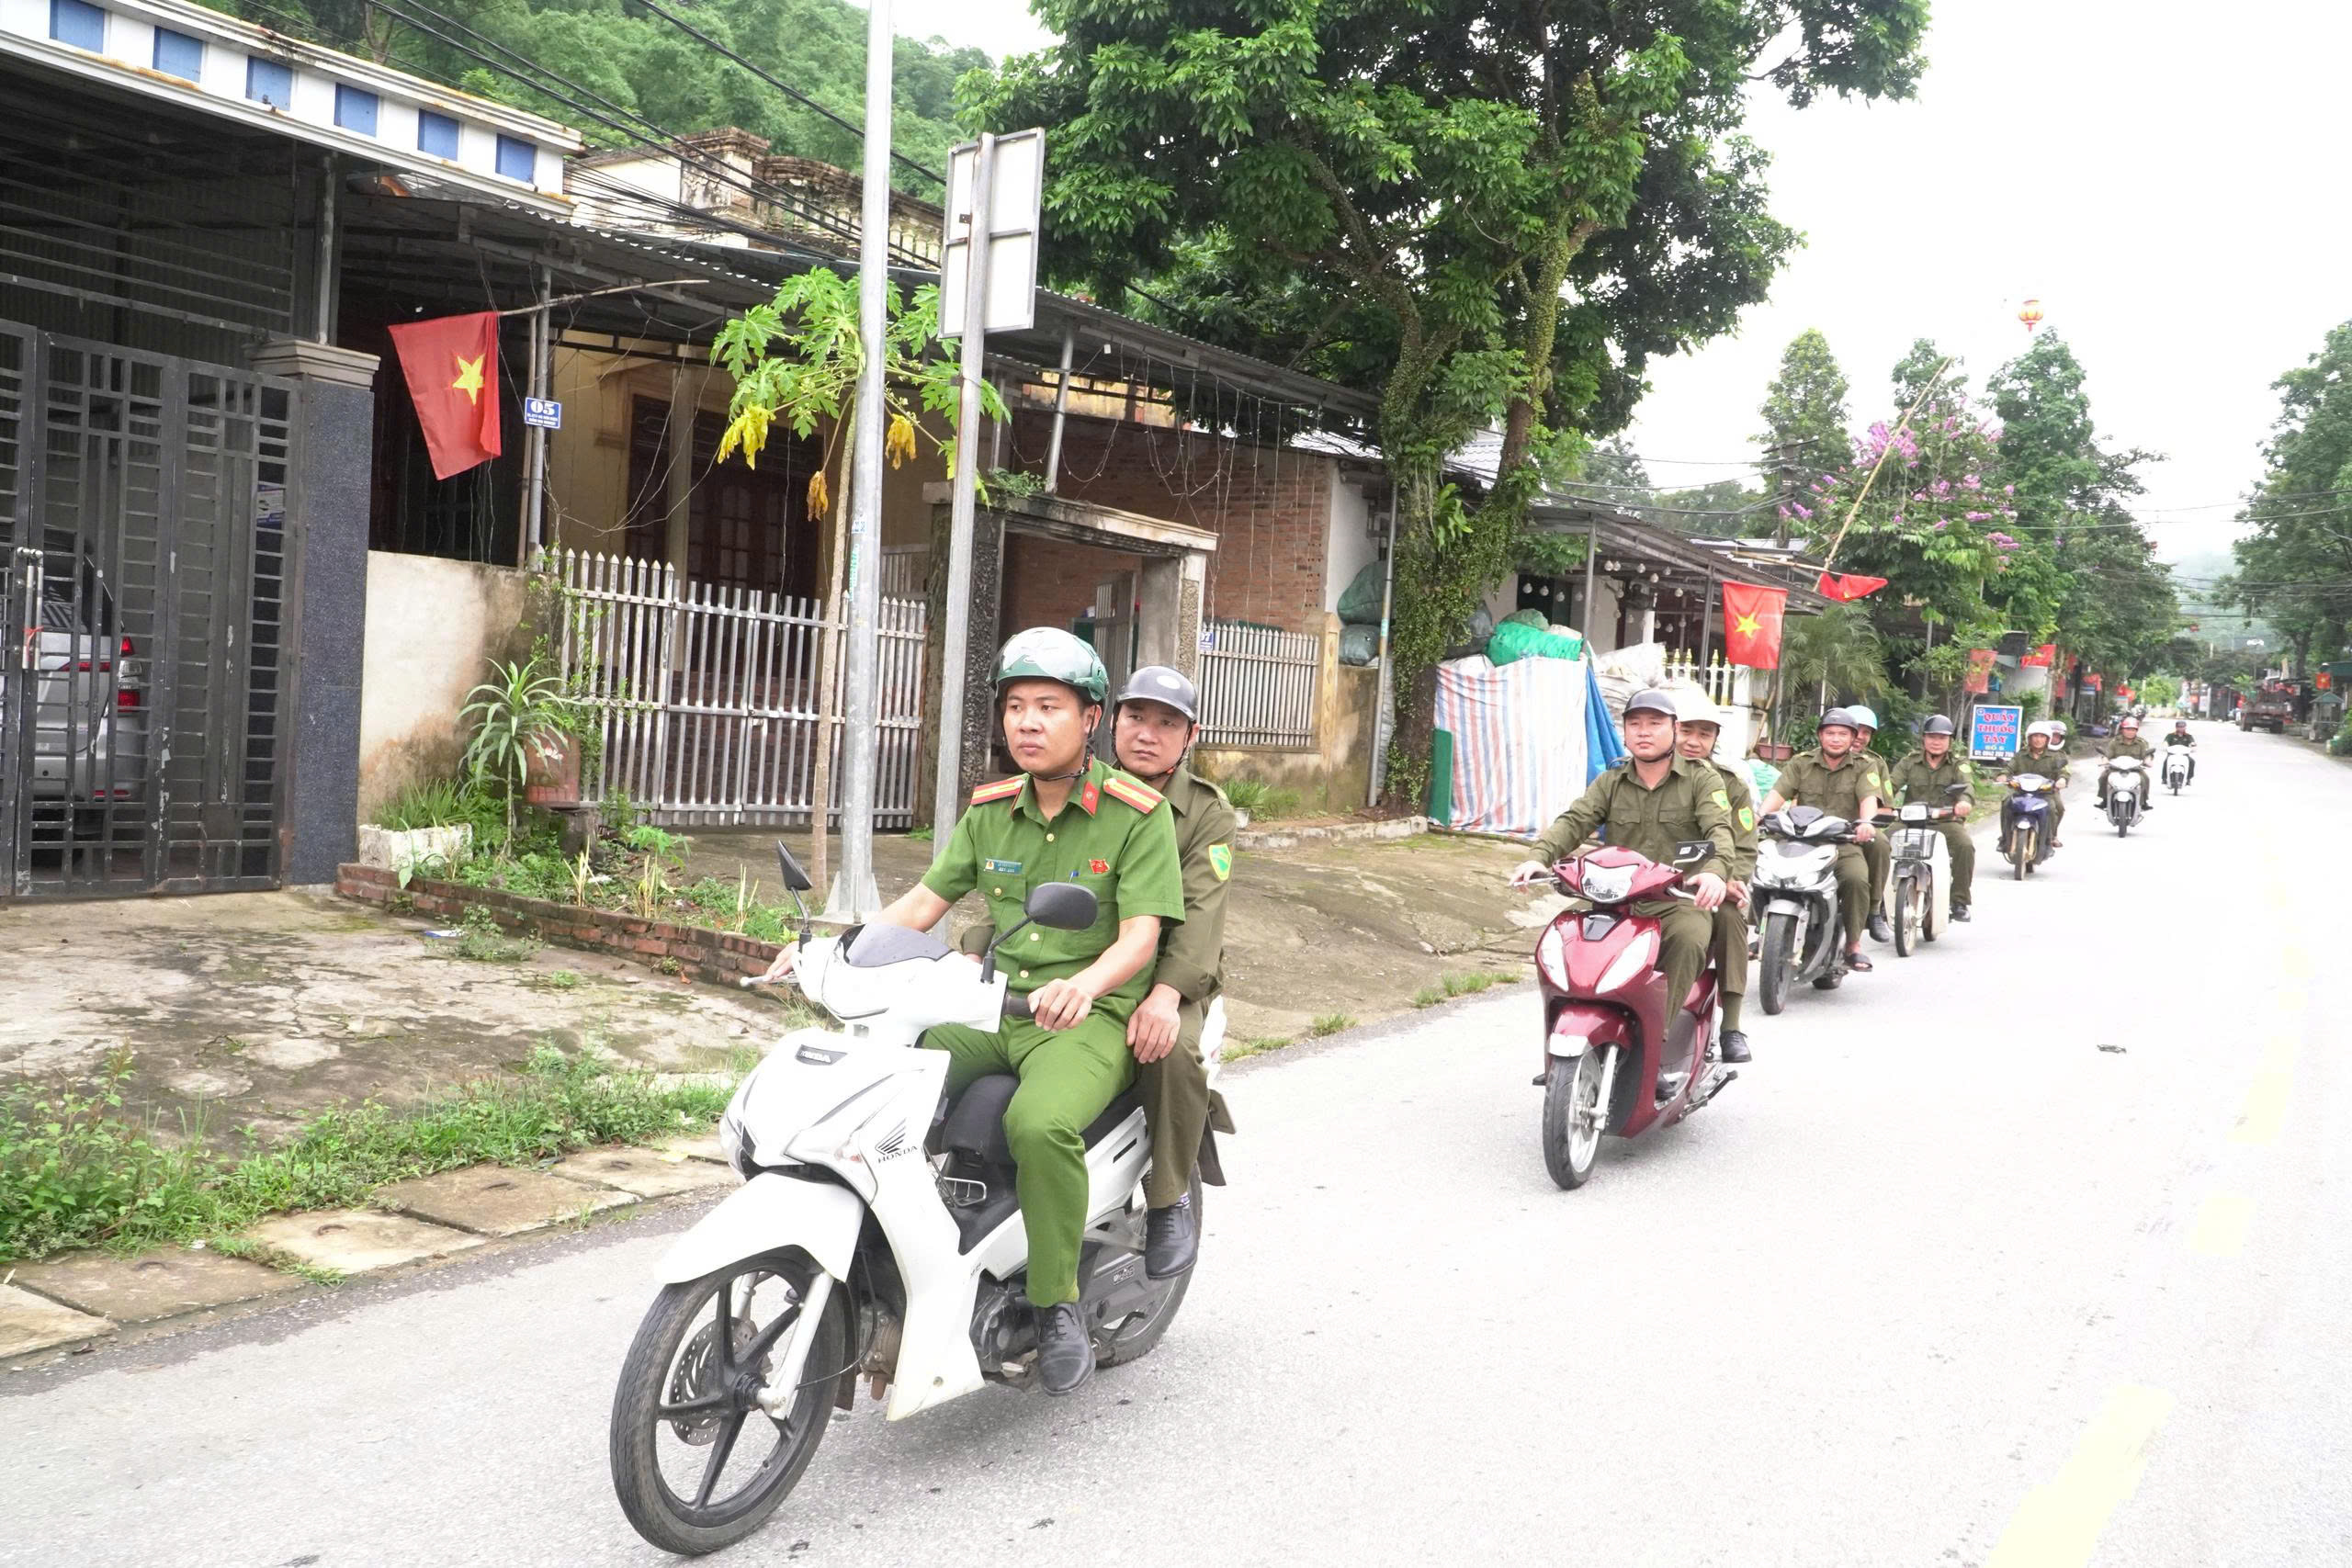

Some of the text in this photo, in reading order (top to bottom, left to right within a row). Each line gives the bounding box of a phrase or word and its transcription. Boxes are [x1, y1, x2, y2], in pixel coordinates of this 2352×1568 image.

[530, 400, 555, 416] 05
[799, 1050, 831, 1063] HONDA
[877, 1145, 918, 1163] HONDA
